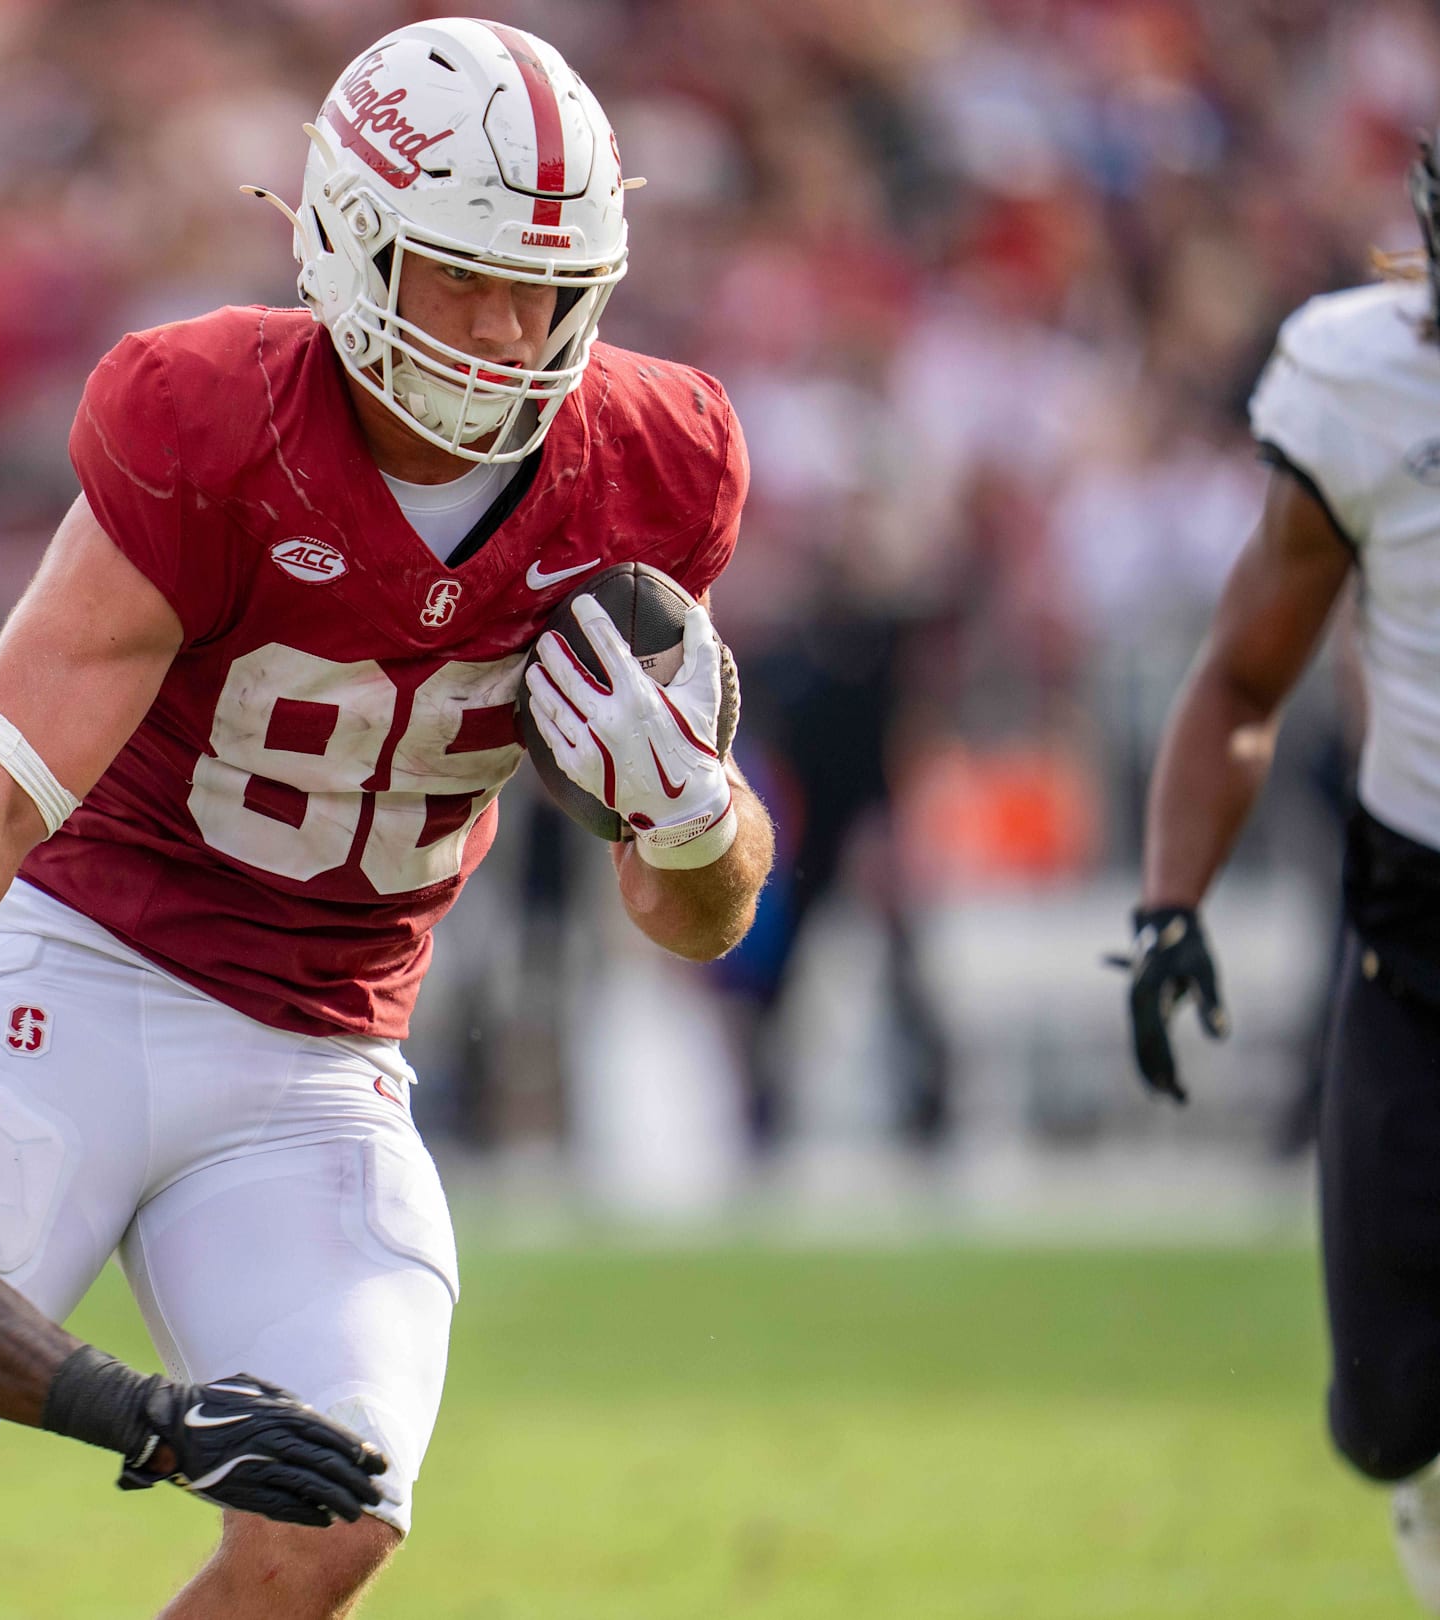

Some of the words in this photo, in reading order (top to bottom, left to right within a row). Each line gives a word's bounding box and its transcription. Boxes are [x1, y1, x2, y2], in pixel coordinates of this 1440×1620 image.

[340, 53, 455, 166] Stanford
[521, 231, 571, 249] CARDINAL
[280, 546, 340, 571] ACC
[186, 642, 530, 896] 86
